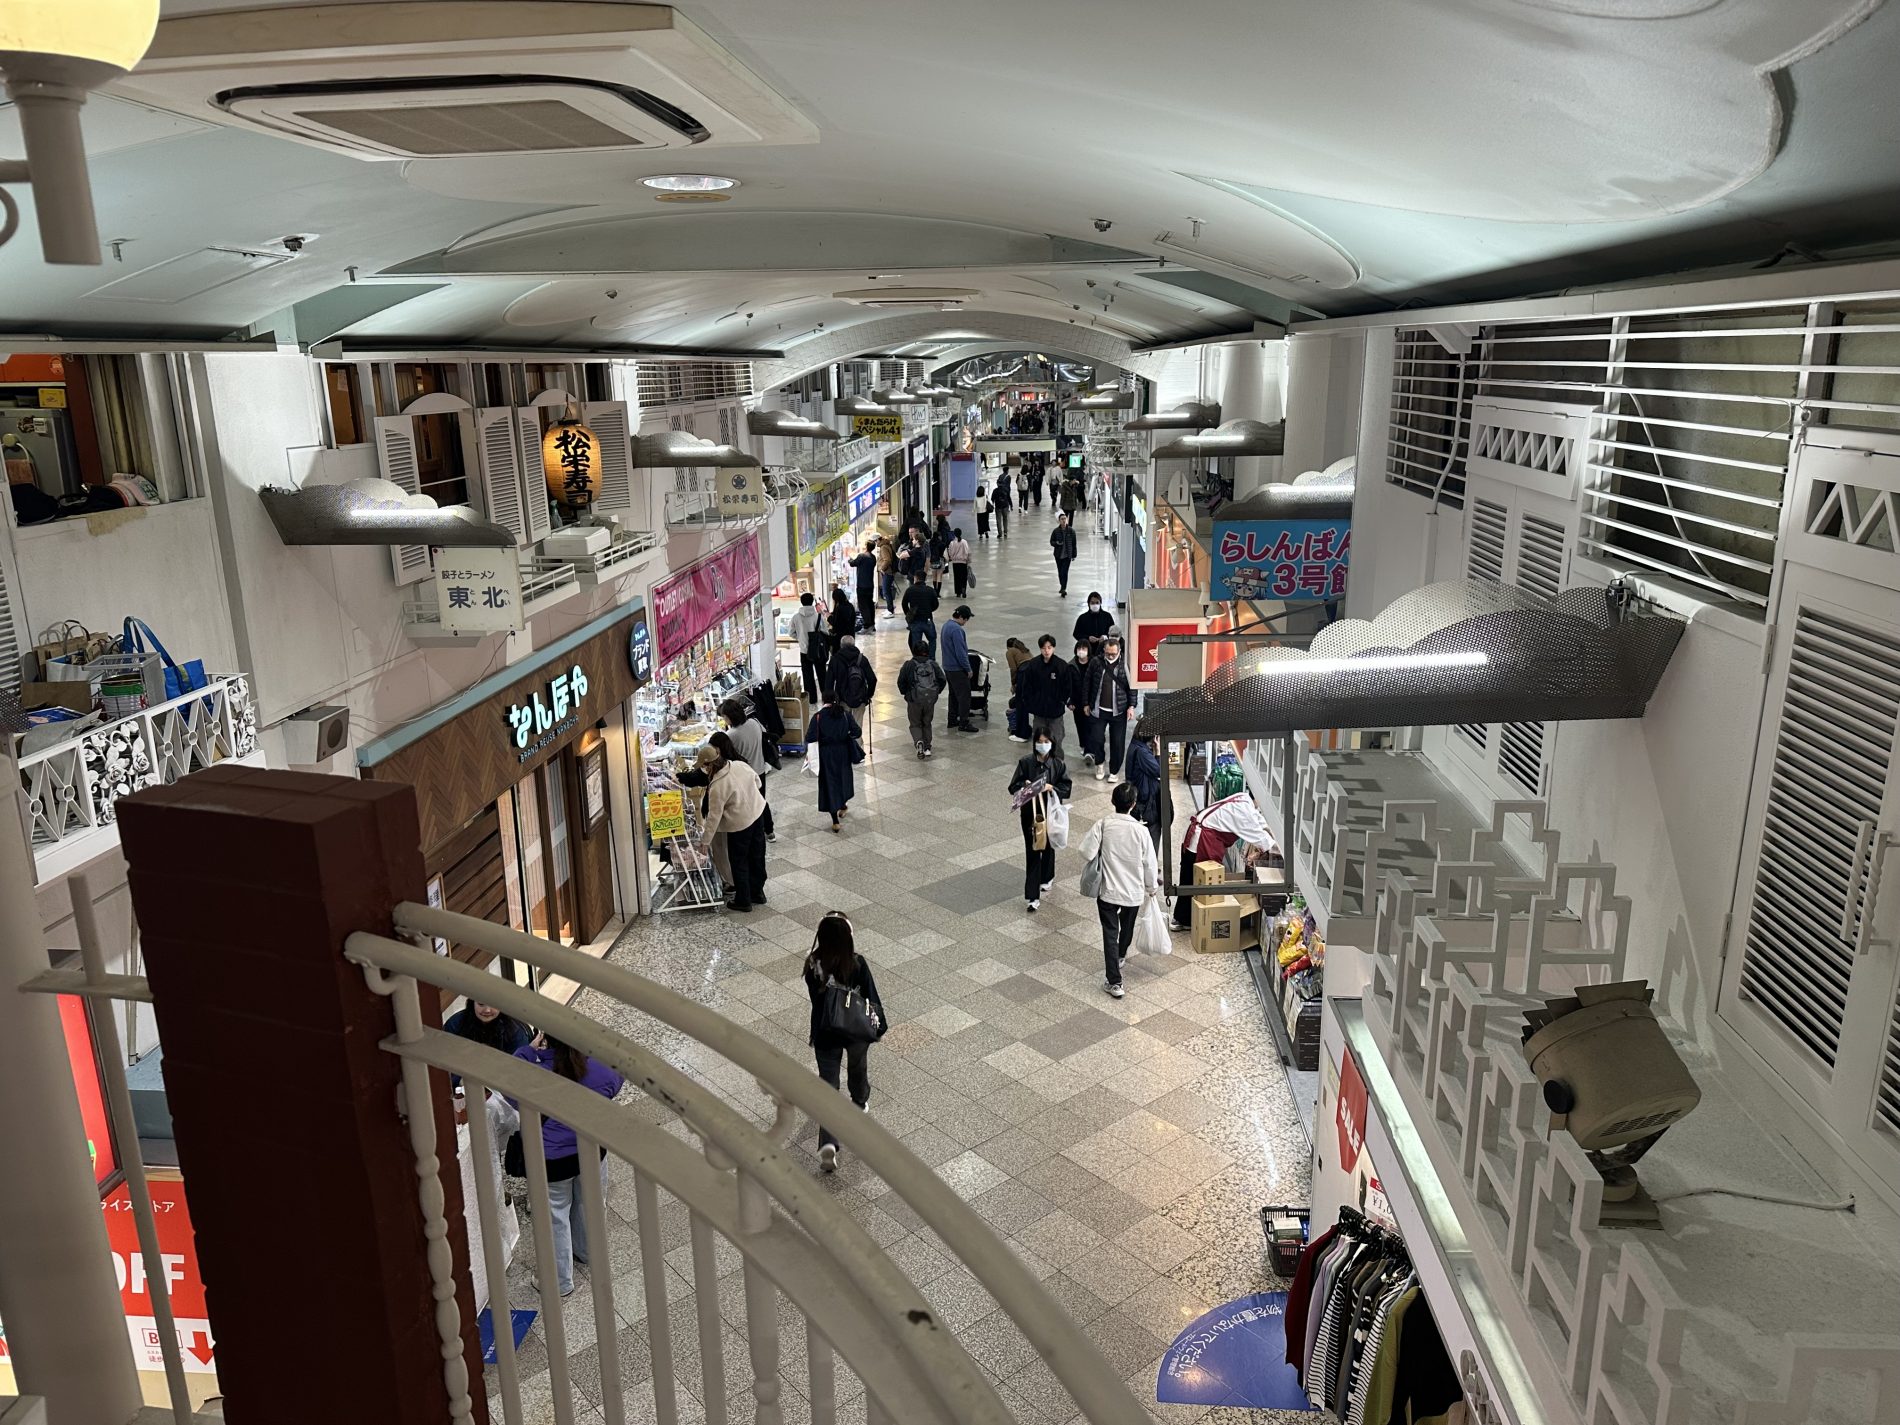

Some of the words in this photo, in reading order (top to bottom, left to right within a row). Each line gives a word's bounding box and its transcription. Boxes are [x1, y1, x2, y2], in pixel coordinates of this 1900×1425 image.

[441, 570, 495, 580] 餃子とラーメン
[509, 664, 588, 749] なんぼや
[520, 744, 539, 763] BRAND
[540, 732, 556, 752] REUSE
[1340, 1096, 1361, 1156] SALE
[101, 1199, 175, 1213] ライストア
[1373, 1195, 1392, 1214] ¥1,0
